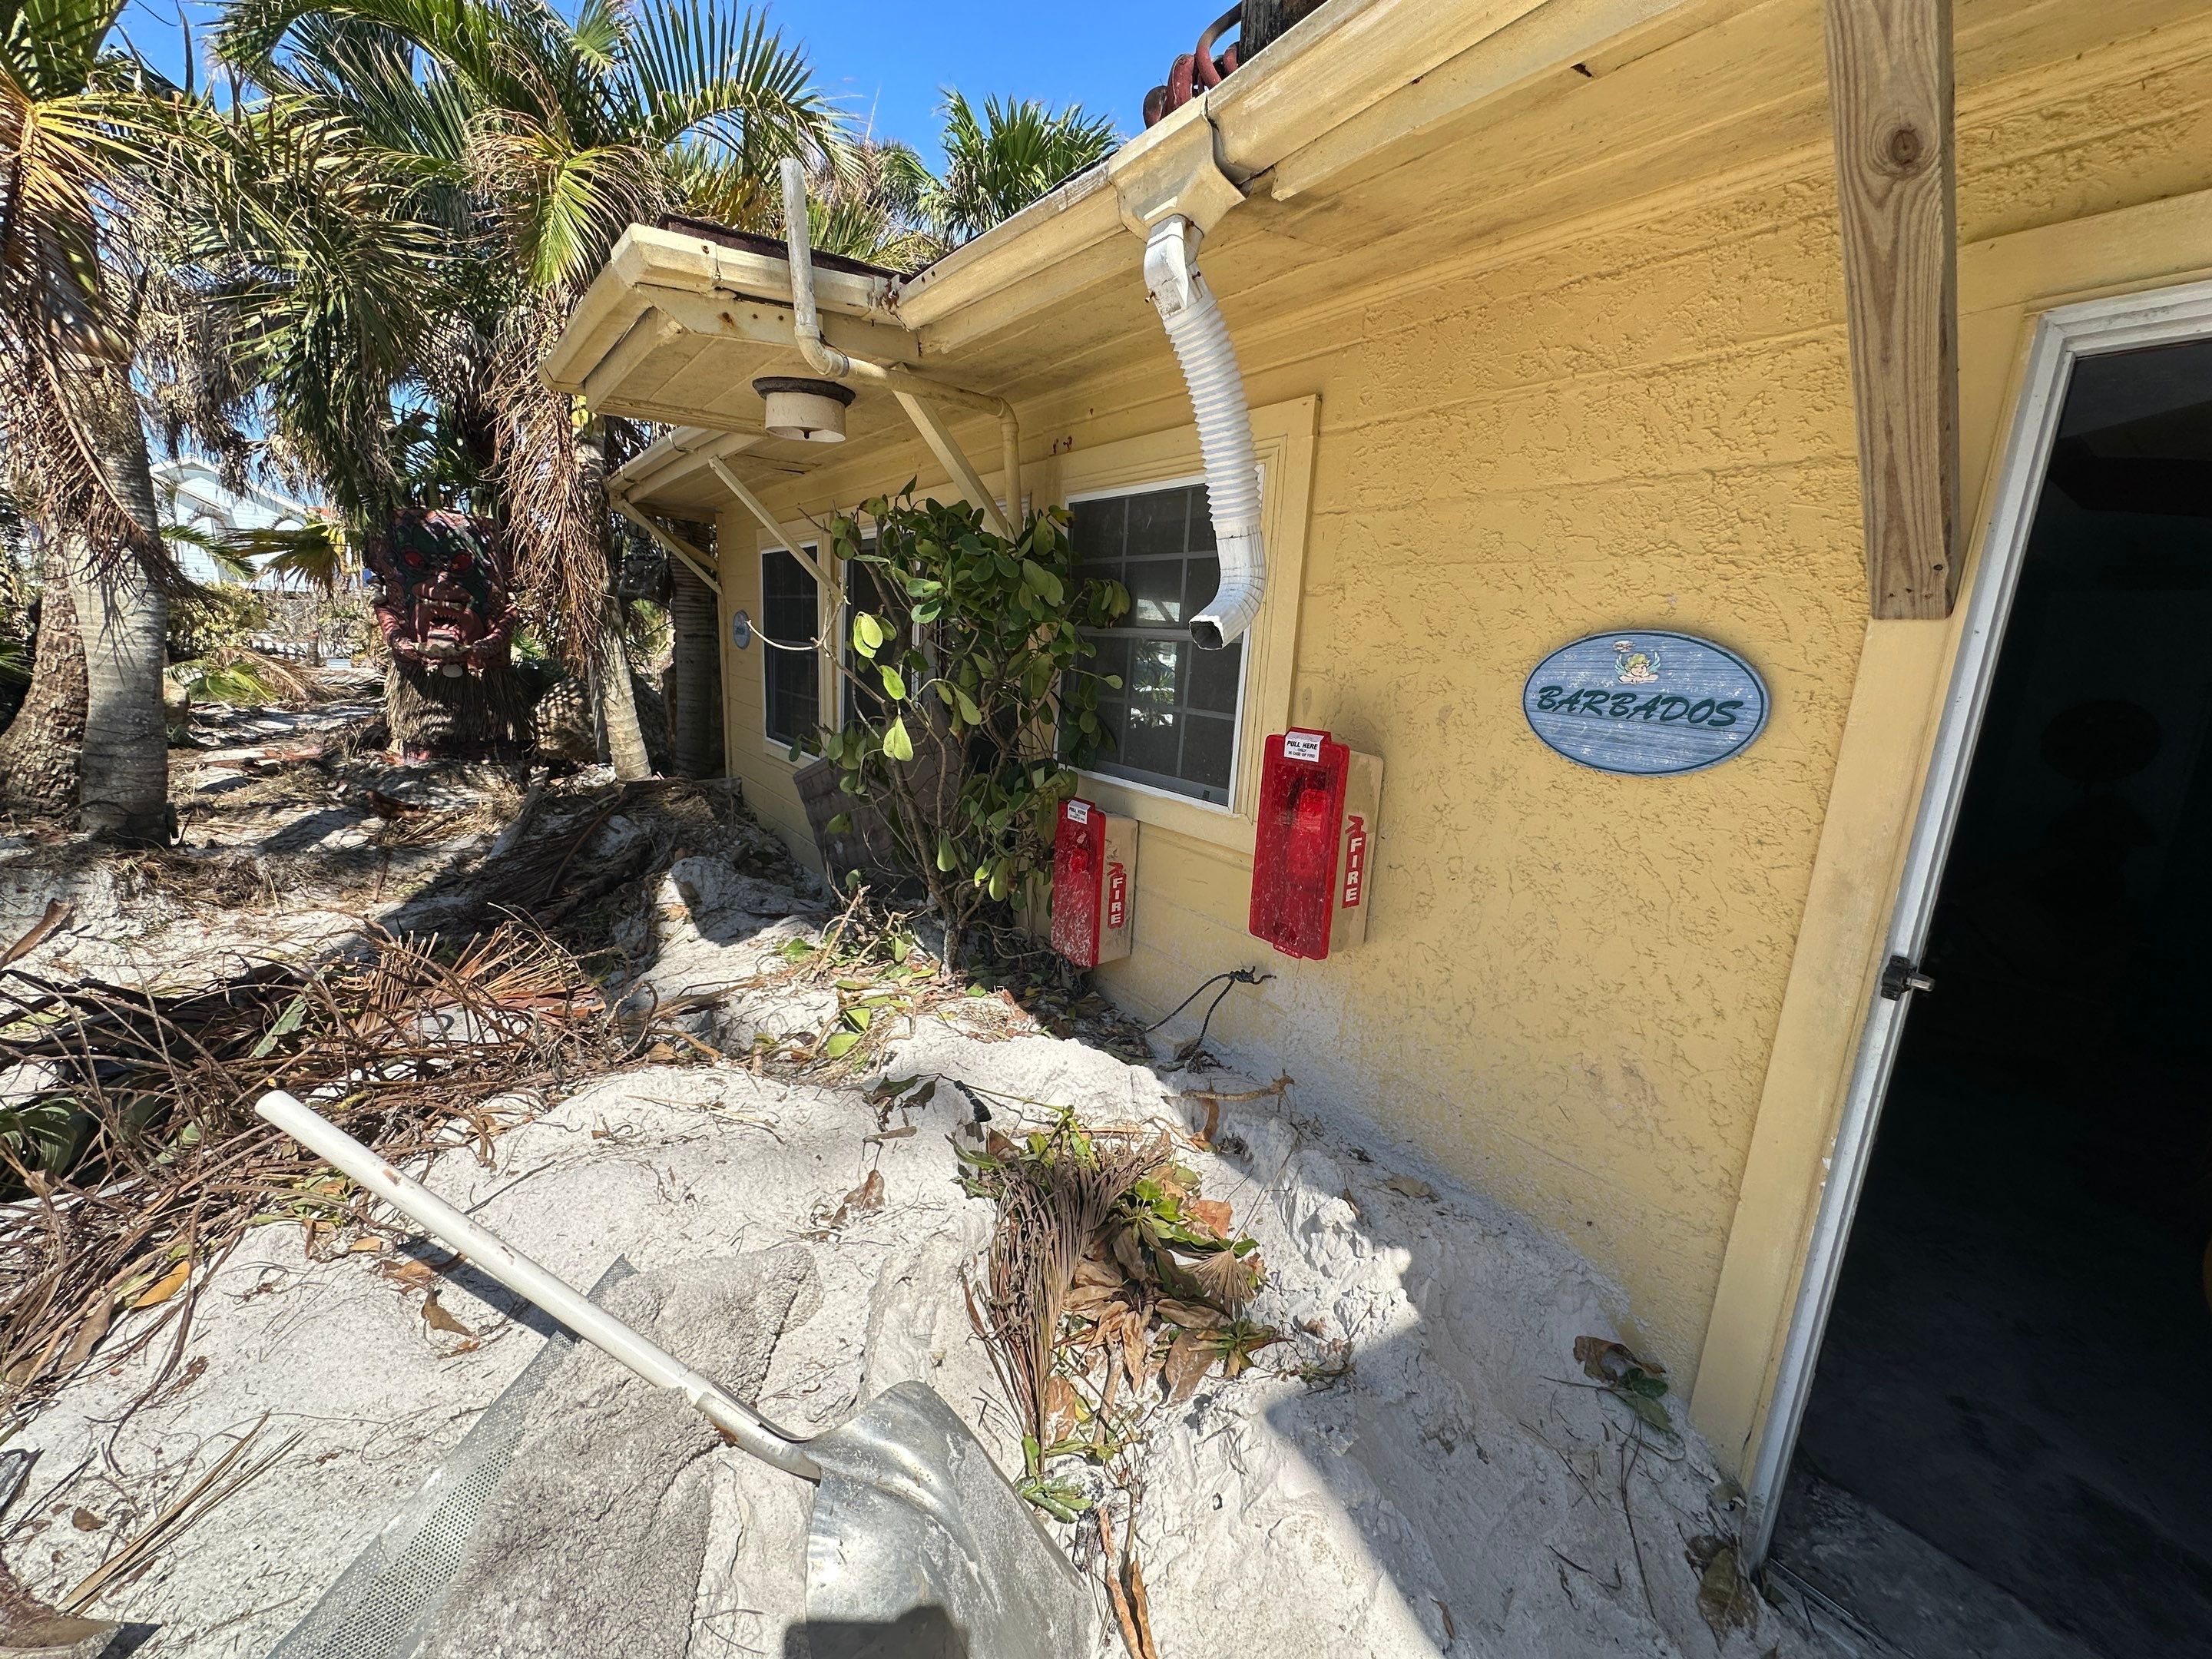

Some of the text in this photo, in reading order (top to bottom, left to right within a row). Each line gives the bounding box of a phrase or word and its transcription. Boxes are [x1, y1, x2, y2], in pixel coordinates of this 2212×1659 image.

[1537, 686, 1743, 727] BARBADOS
[1346, 837, 1363, 902] FIRE
[1111, 877, 1123, 924] FIRE
